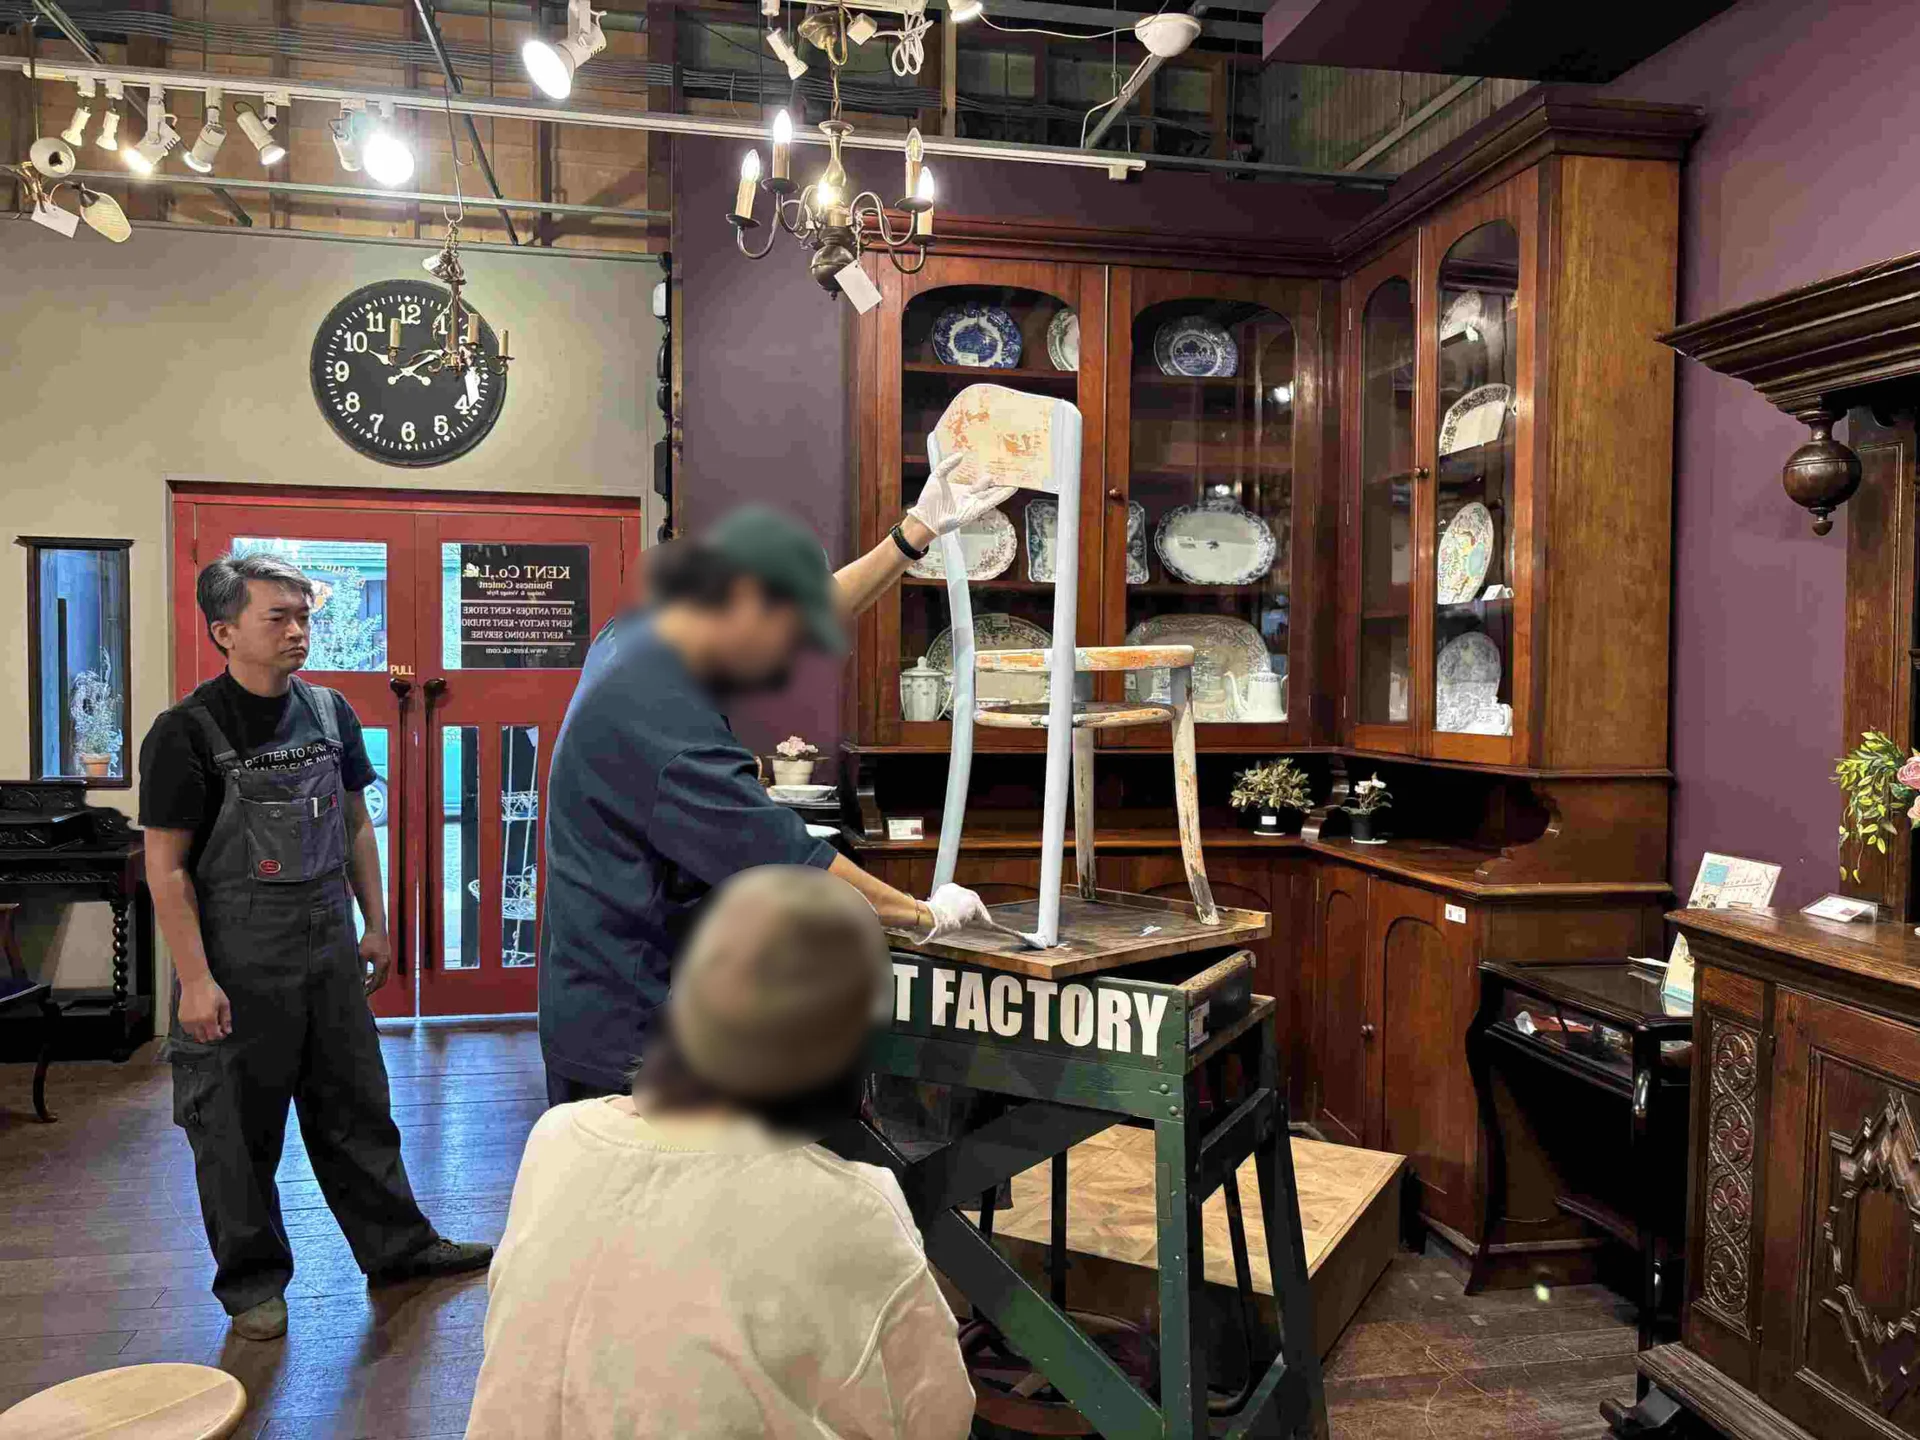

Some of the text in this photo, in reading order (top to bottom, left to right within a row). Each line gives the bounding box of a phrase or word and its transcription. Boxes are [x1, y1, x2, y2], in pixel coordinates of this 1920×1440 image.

[366, 312, 385, 332] 11
[398, 304, 421, 325] 12
[344, 332, 368, 353] 10
[335, 361, 350, 382] 9
[345, 392, 361, 413] 8
[369, 414, 384, 434] 7
[401, 422, 416, 442] 6
[434, 415, 449, 436] 5
[389, 664, 415, 676] PULL
[289, 747, 306, 759] TO
[931, 967, 1169, 1057] FACTORY
